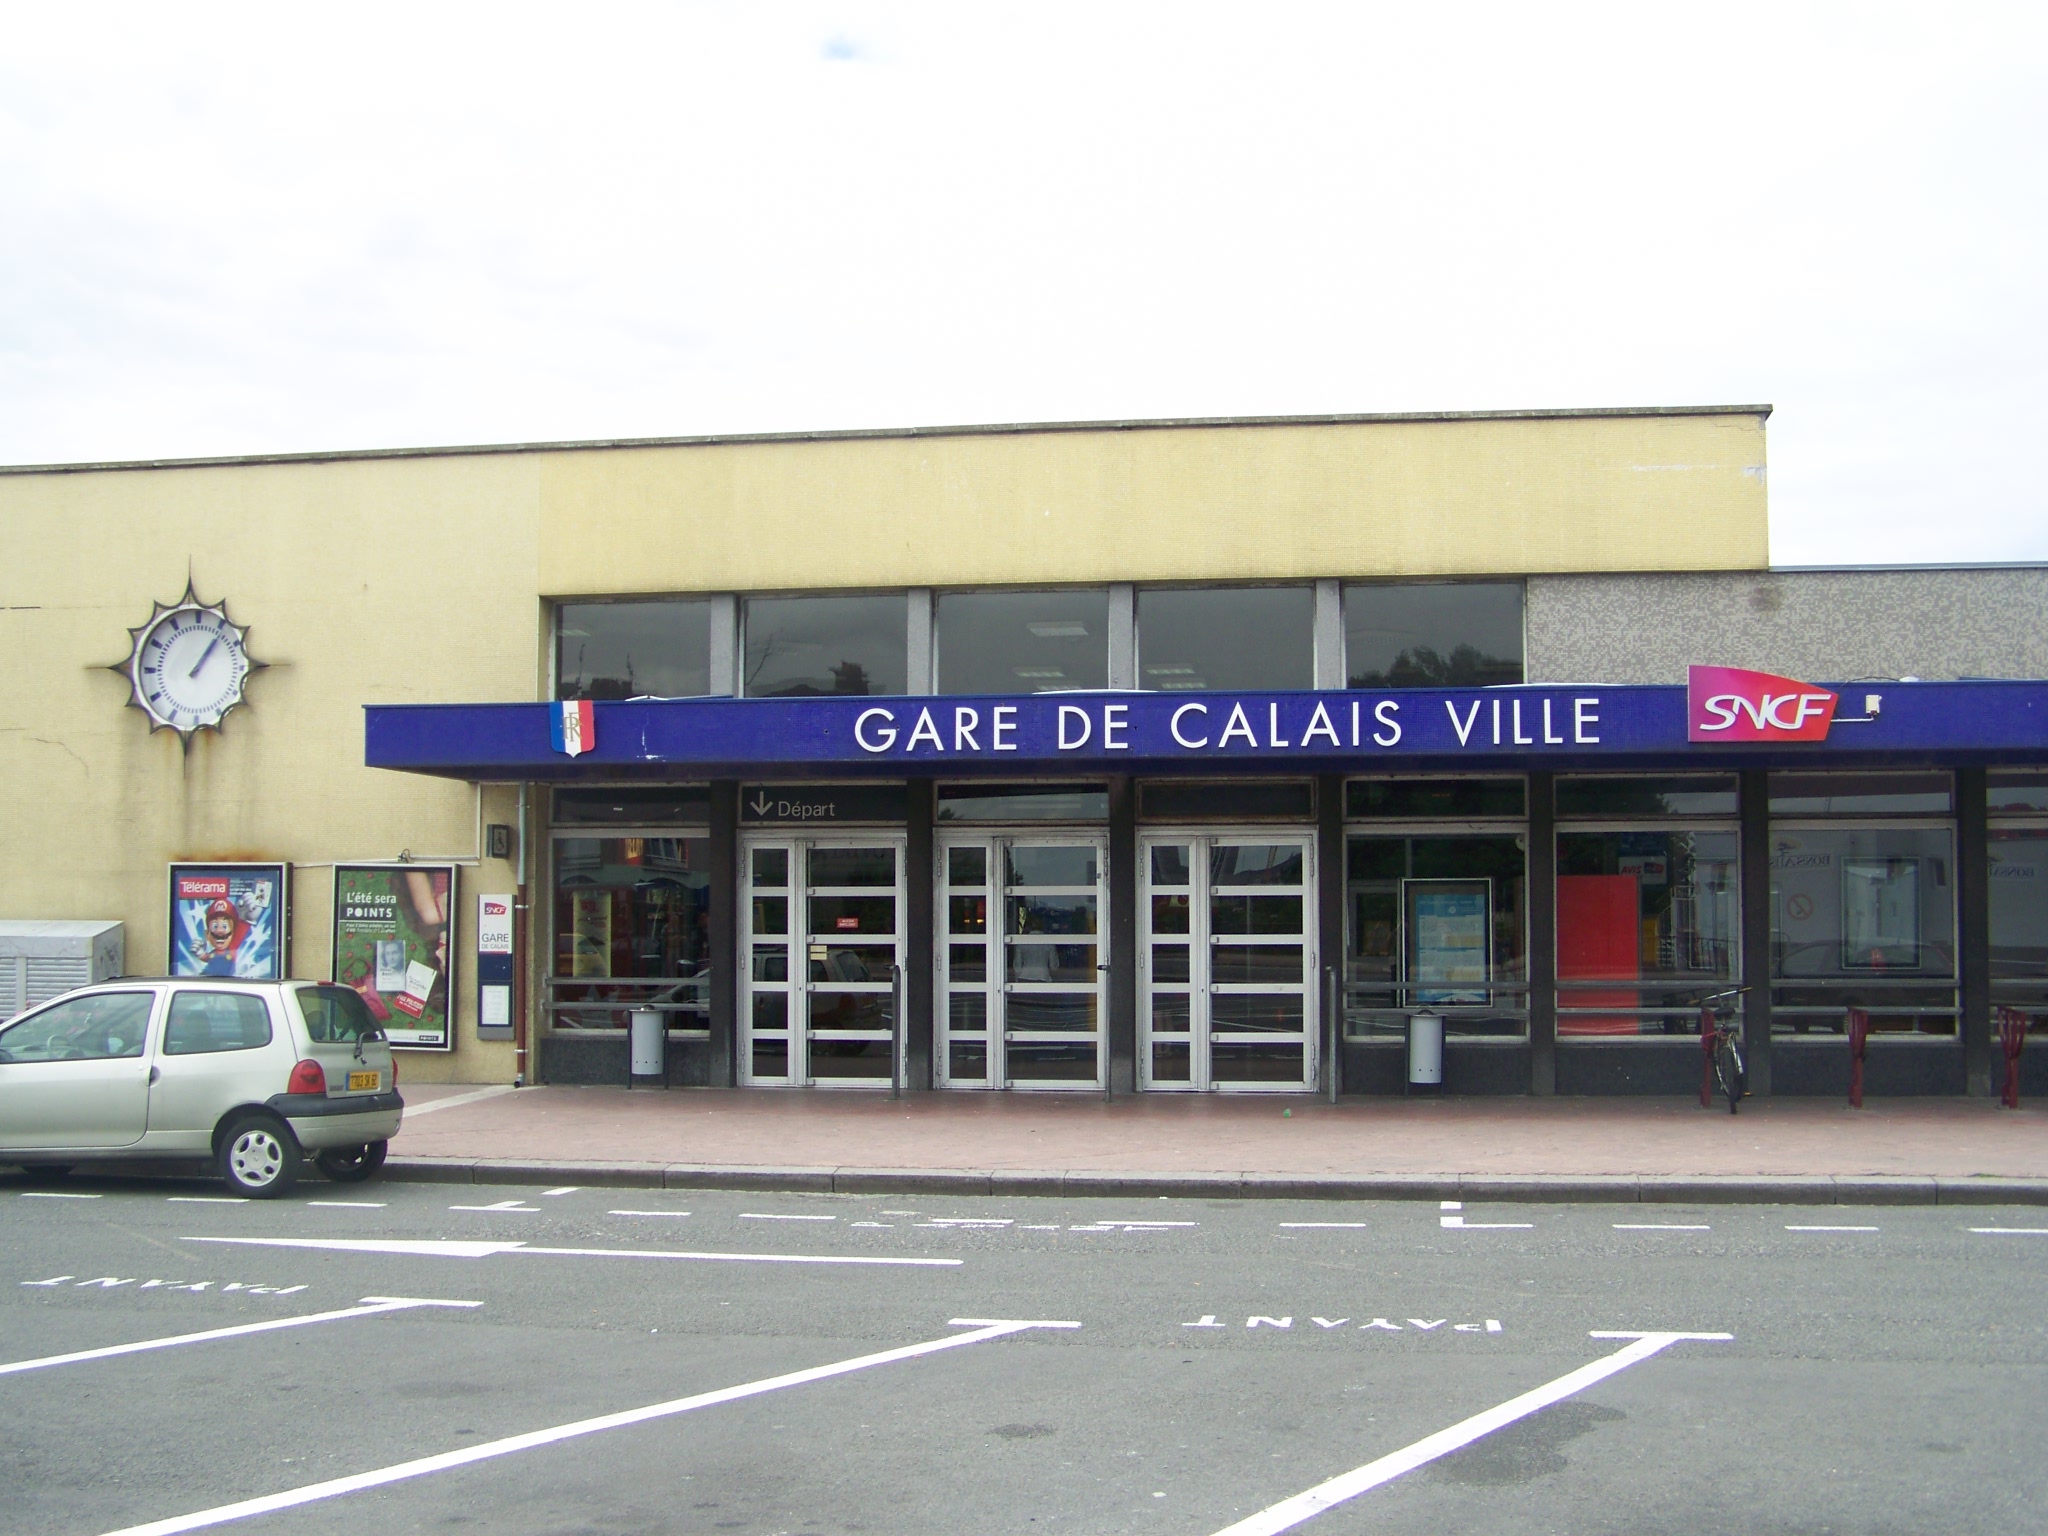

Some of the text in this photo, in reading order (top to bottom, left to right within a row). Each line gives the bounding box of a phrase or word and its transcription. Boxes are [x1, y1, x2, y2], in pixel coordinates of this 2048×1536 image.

[1699, 694, 1832, 731] SNCF
[854, 698, 1600, 753] GARE DE CALAIS VILLE
[778, 800, 836, 821] Départ
[180, 881, 227, 894] Télérama
[346, 891, 397, 904] L'été sera
[346, 907, 393, 918] POINTS
[485, 905, 506, 915] SNCF
[481, 933, 509, 943] GARE
[1182, 1314, 1502, 1332] PAYANT
